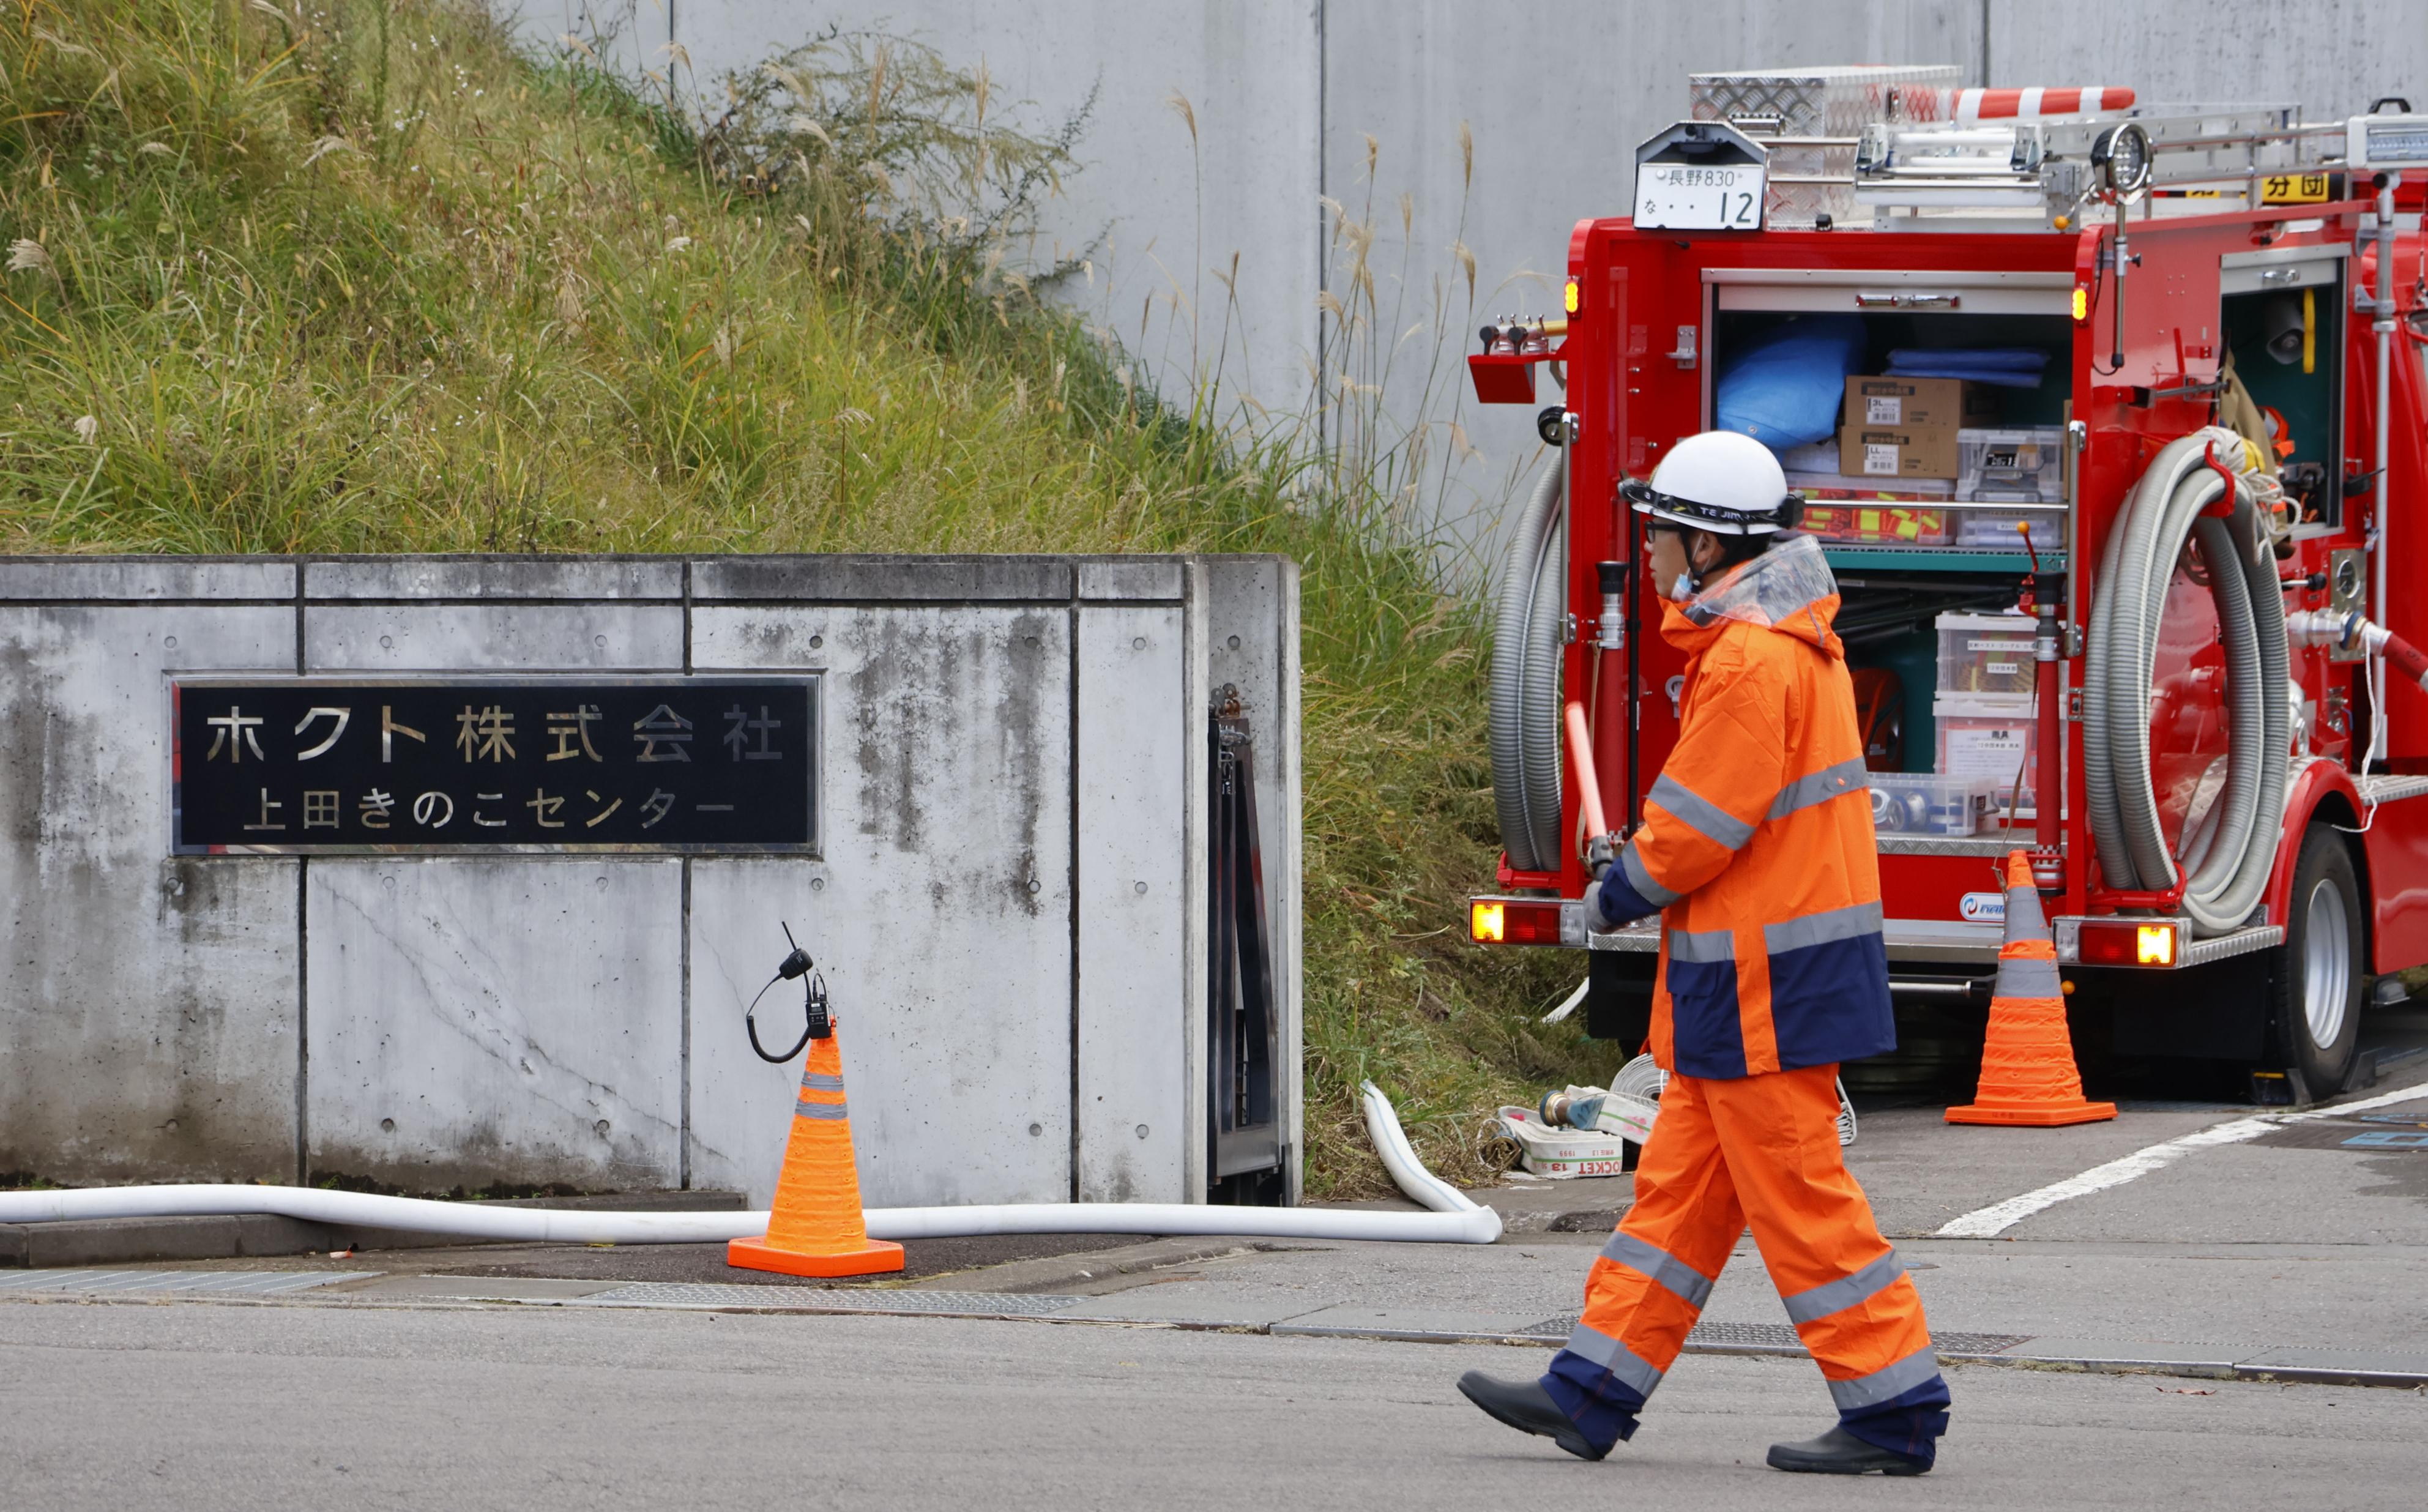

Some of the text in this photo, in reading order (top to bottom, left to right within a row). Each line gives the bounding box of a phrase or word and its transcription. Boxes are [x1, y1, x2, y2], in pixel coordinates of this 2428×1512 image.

[1644, 198, 1656, 215] な
[207, 704, 783, 764] ホクト株式会社
[243, 788, 734, 831] 上田きのこセンター
[1551, 1163, 1568, 1172] 13
